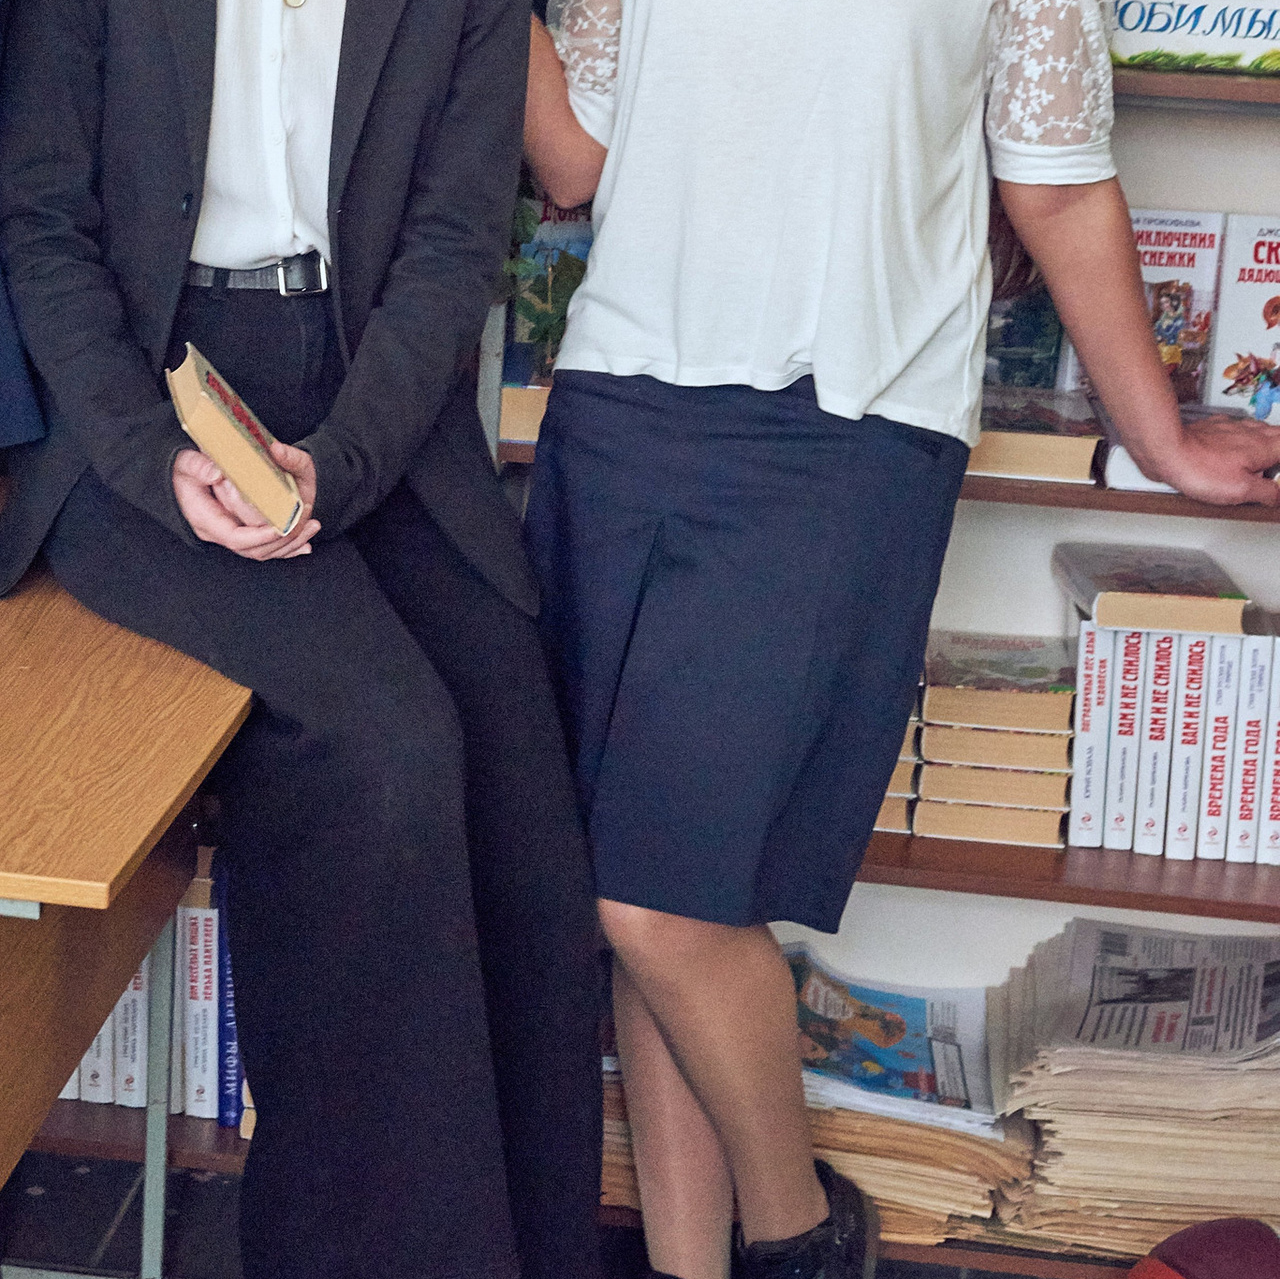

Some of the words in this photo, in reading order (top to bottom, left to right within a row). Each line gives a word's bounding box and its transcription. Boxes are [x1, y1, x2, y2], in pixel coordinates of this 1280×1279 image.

[1114, 0, 1280, 40] ЮБИМЫ
[1122, 631, 1142, 682] СНИЛОСЬ
[1153, 636, 1173, 686] СНИЛОСЬ
[1185, 640, 1206, 691] СНИЛОСЬ
[1081, 674, 1094, 732] ПОГРАНИЧНЫЙ
[1119, 701, 1137, 710] И
[1120, 684, 1138, 699] НЕ
[1152, 689, 1169, 704] НЕ
[1184, 693, 1202, 708] НЕ
[1117, 713, 1136, 736] ВАМ
[1150, 706, 1168, 715] И
[1183, 711, 1200, 719] И
[1149, 718, 1167, 741] ВАМ
[1181, 721, 1199, 745] ВАМ
[1213, 715, 1229, 751] ГОДА
[1244, 719, 1261, 755] ГОДА
[1207, 754, 1226, 817] ВРЕМЕНА
[1239, 758, 1258, 821] ВРЕМЕНА
[223, 1041, 238, 1096] МИФЫ
